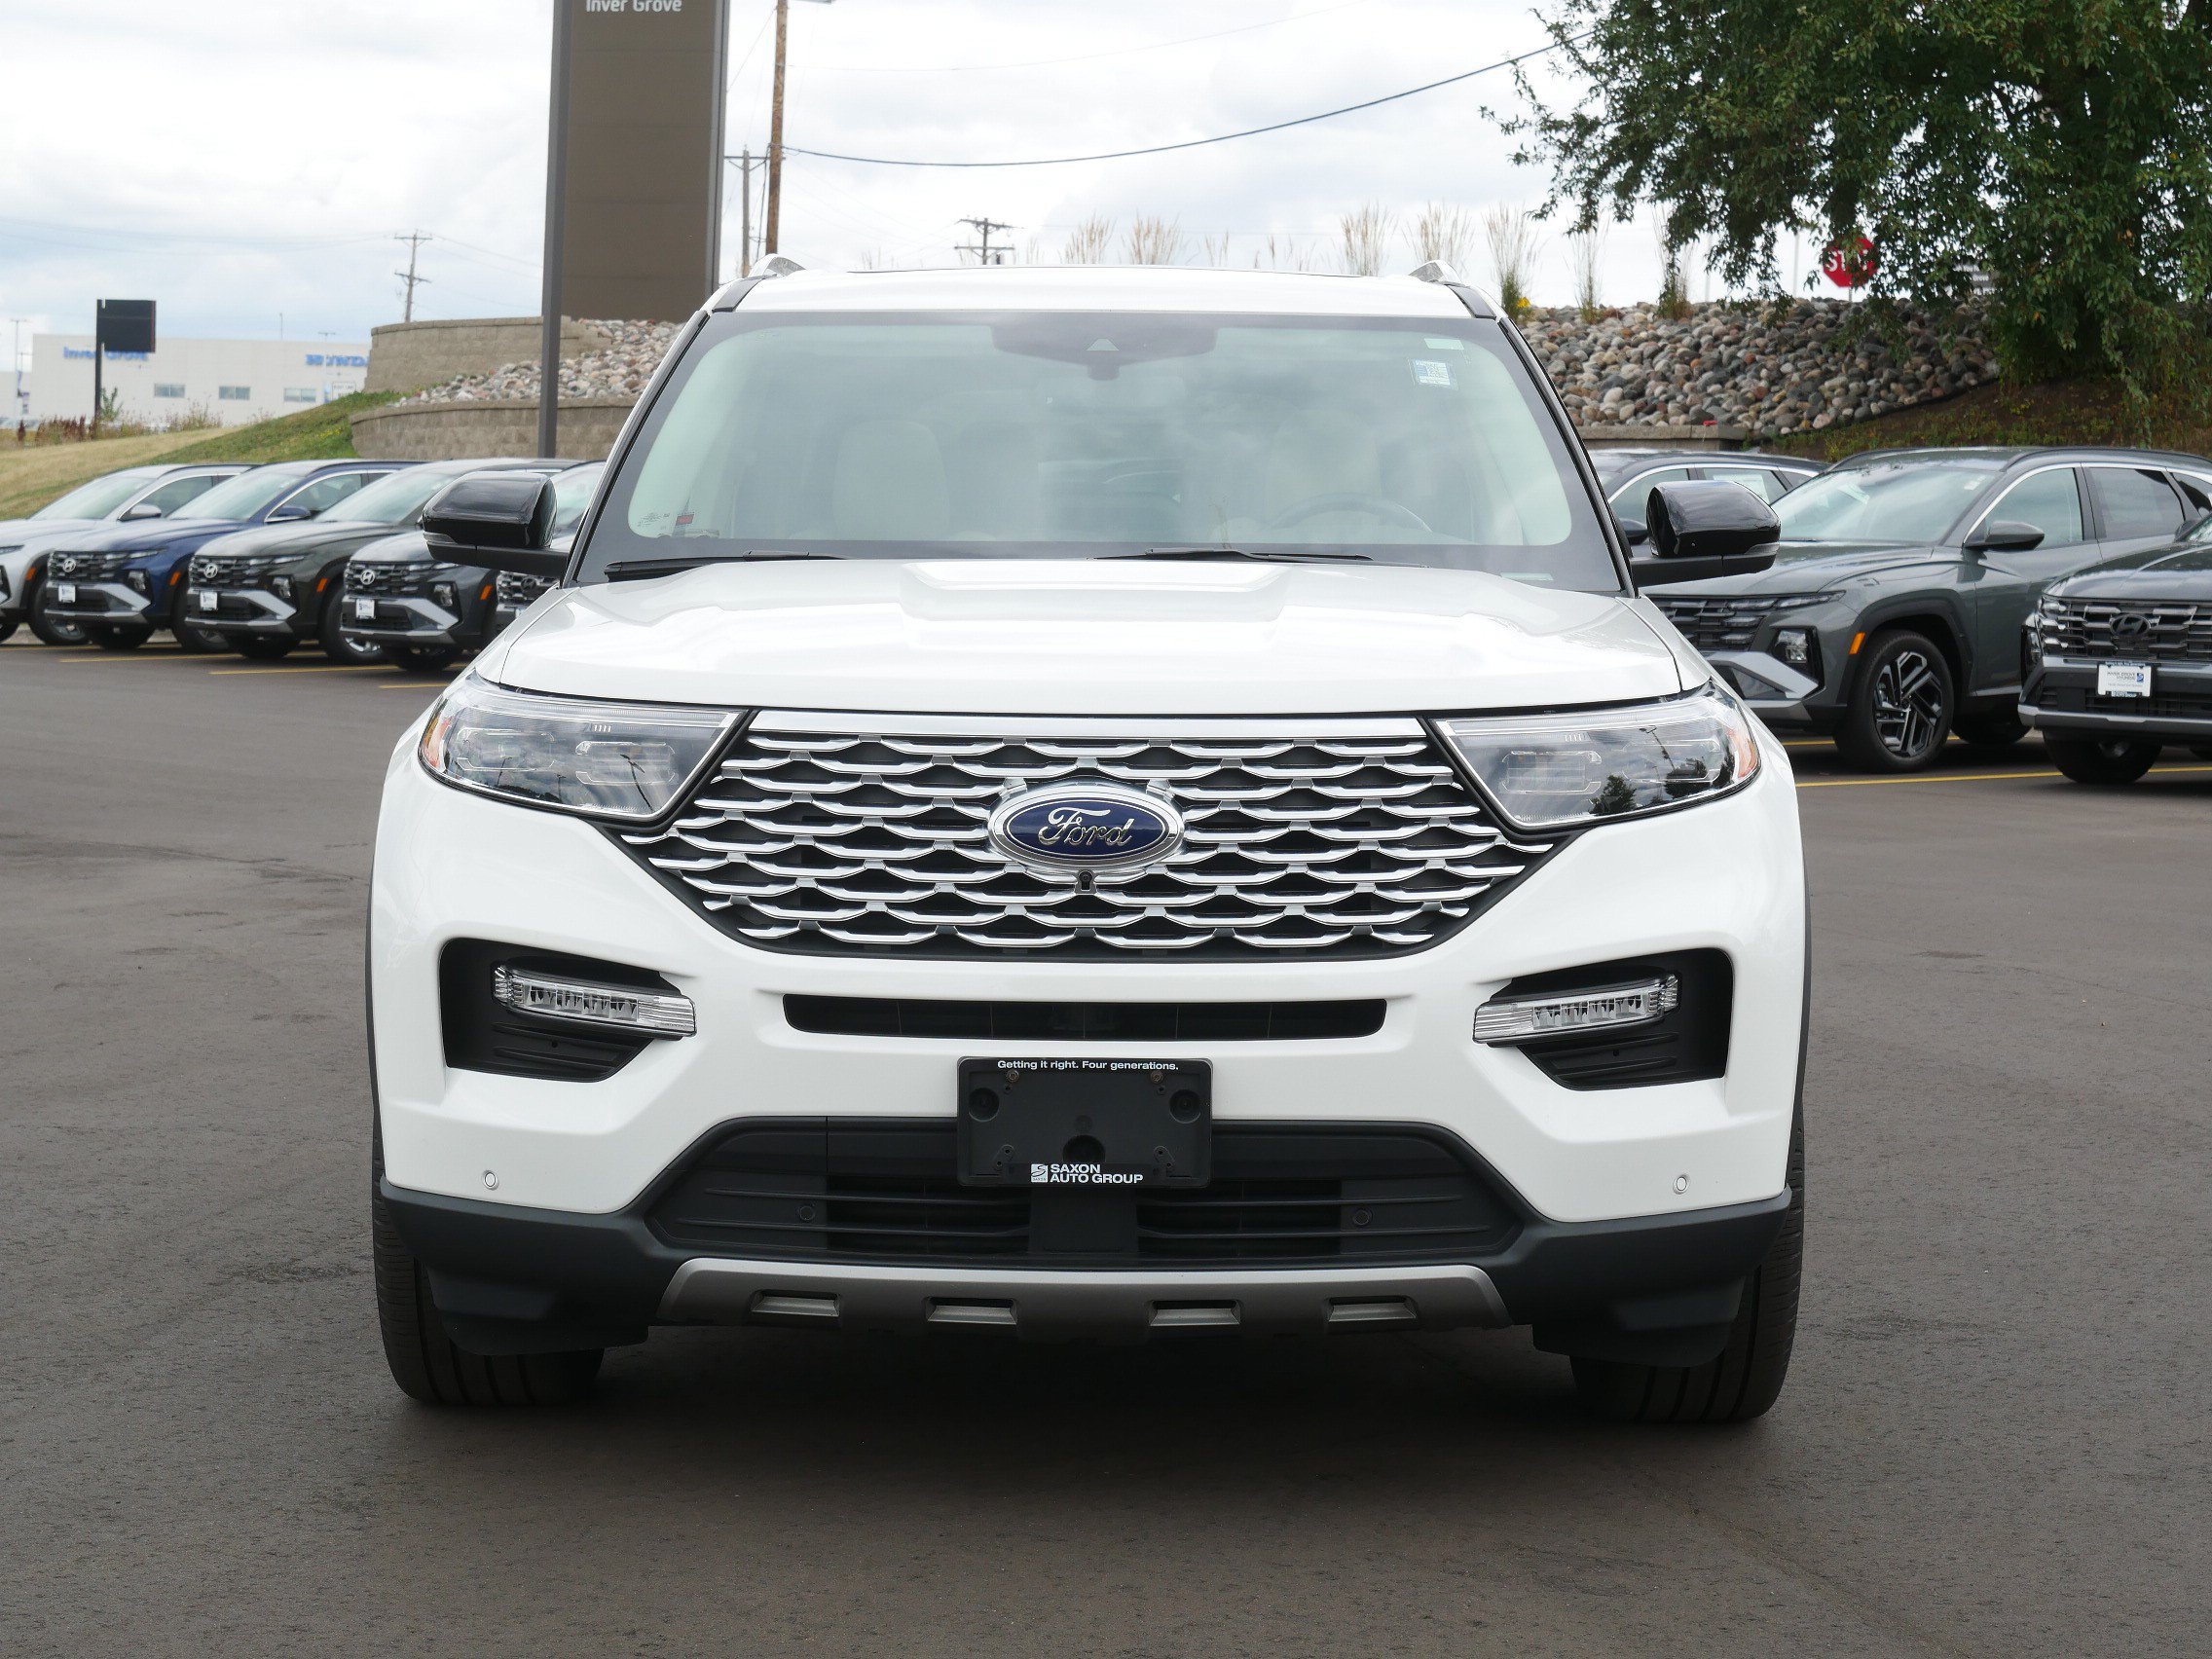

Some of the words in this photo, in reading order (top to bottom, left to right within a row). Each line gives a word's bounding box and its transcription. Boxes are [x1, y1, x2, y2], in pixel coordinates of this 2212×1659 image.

[586, 0, 628, 13] Inver
[633, 0, 682, 13] Grove
[1038, 806, 1135, 846] Ford
[997, 1060, 1038, 1070] Getting
[1040, 1060, 1049, 1069] it
[1050, 1060, 1079, 1070] right.
[1082, 1060, 1108, 1069] Four
[1110, 1061, 1179, 1071] generations.
[1050, 1163, 1101, 1174] SAXON
[1050, 1173, 1089, 1184] AUTO
[1091, 1173, 1144, 1184] GROUP
